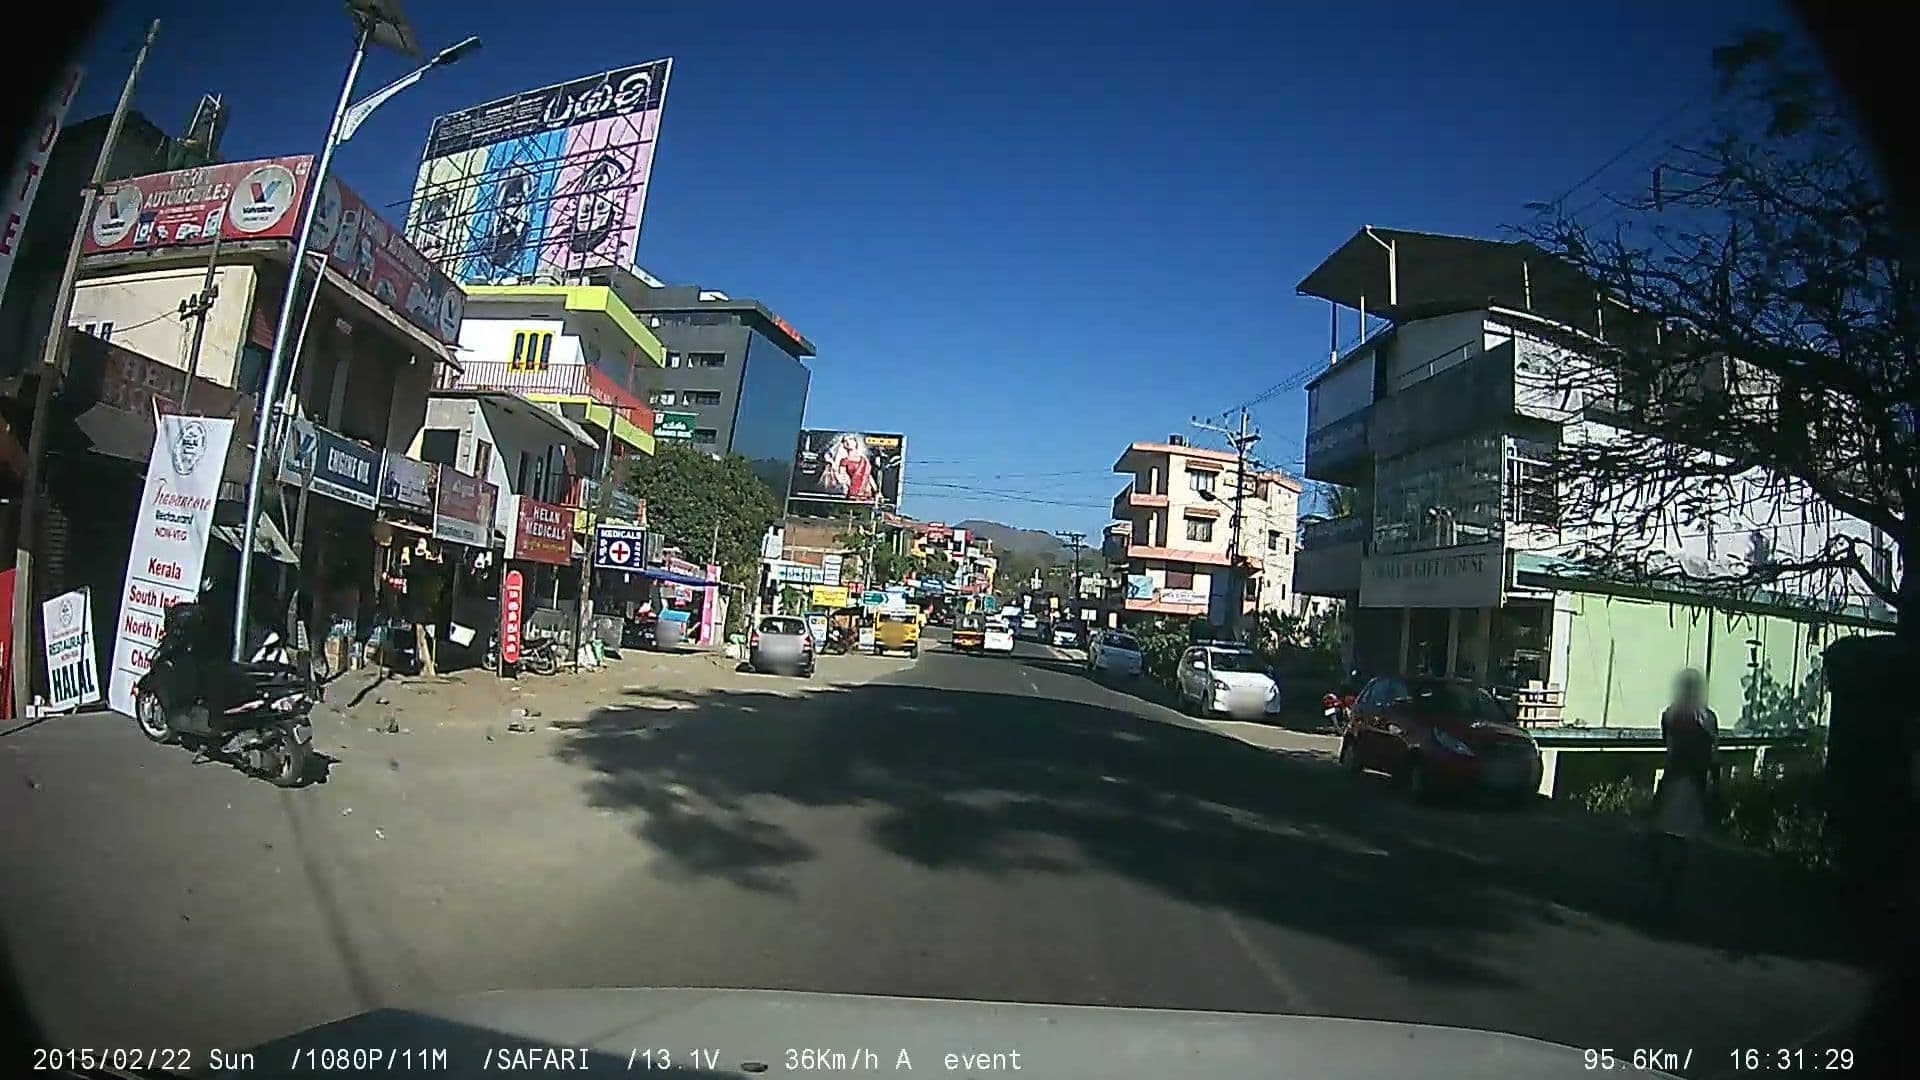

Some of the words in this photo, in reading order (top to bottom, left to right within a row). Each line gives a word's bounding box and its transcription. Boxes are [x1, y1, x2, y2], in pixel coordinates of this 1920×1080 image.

[525, 520, 567, 541] MEDICALS
[600, 528, 642, 540] MEDICALS
[147, 556, 182, 581] Kerala
[128, 584, 158, 608] South
[124, 615, 153, 639] North
[52, 658, 95, 703] HALAL
